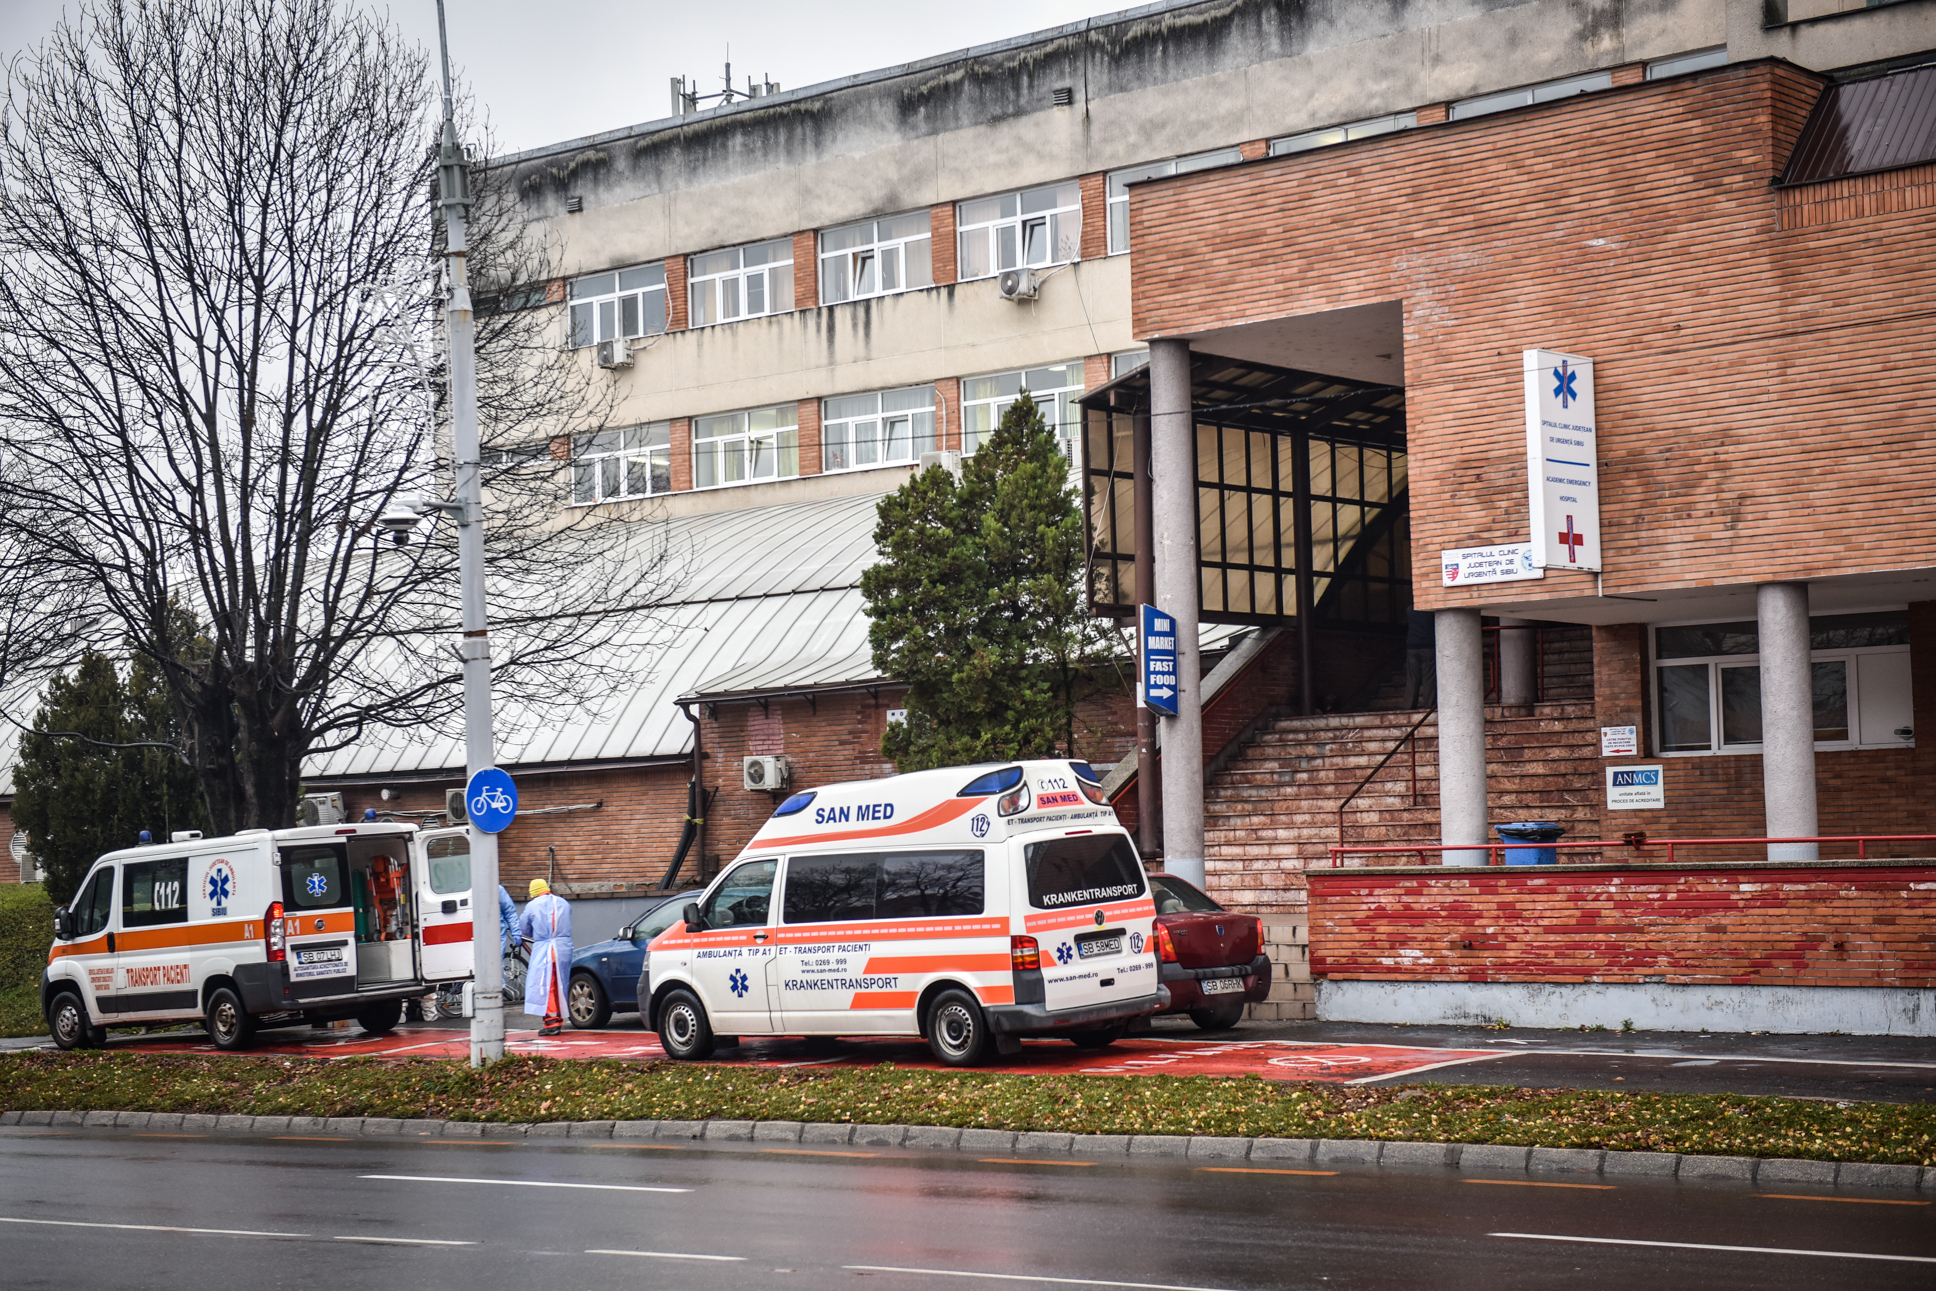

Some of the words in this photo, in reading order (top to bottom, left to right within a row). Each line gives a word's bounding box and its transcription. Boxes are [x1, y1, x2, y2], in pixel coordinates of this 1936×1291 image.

[1542, 420, 1558, 428] SPITALUL
[1546, 476, 1566, 484] ACADEMIC
[1566, 478, 1591, 487] EMERGENCY
[1462, 551, 1495, 559] SPITALUL
[1154, 618, 1170, 632] MINI
[1148, 636, 1174, 650] MARKET
[1150, 662, 1174, 672] FAST
[1150, 675, 1175, 685] FOOD
[1047, 778, 1068, 789] 112
[1616, 772, 1656, 784] ANMCS
[1040, 796, 1058, 805] SAN
[1060, 794, 1078, 803] MED
[815, 806, 850, 824] SAN
[856, 803, 894, 821] MED
[1018, 816, 1045, 824] TRANSPORT
[159, 881, 180, 909] 112
[1043, 884, 1137, 906] KRANKENTRANSPORT
[212, 908, 227, 916] SIBIU
[244, 924, 254, 939] A1
[286, 919, 300, 935] A1
[748, 948, 760, 956] TIP
[794, 945, 836, 954] TRANSPORT
[1082, 942, 1094, 954] SB
[1097, 939, 1120, 952] 58MED
[303, 952, 314, 962] SB
[126, 966, 161, 987] TRANSPORT
[162, 964, 190, 985] PACIENTI
[1048, 972, 1098, 984] www.san-med.ro
[784, 977, 898, 991] KRANKENTRANSPORT
[1206, 980, 1218, 990] SB
[1220, 979, 1243, 990] 06RHK
